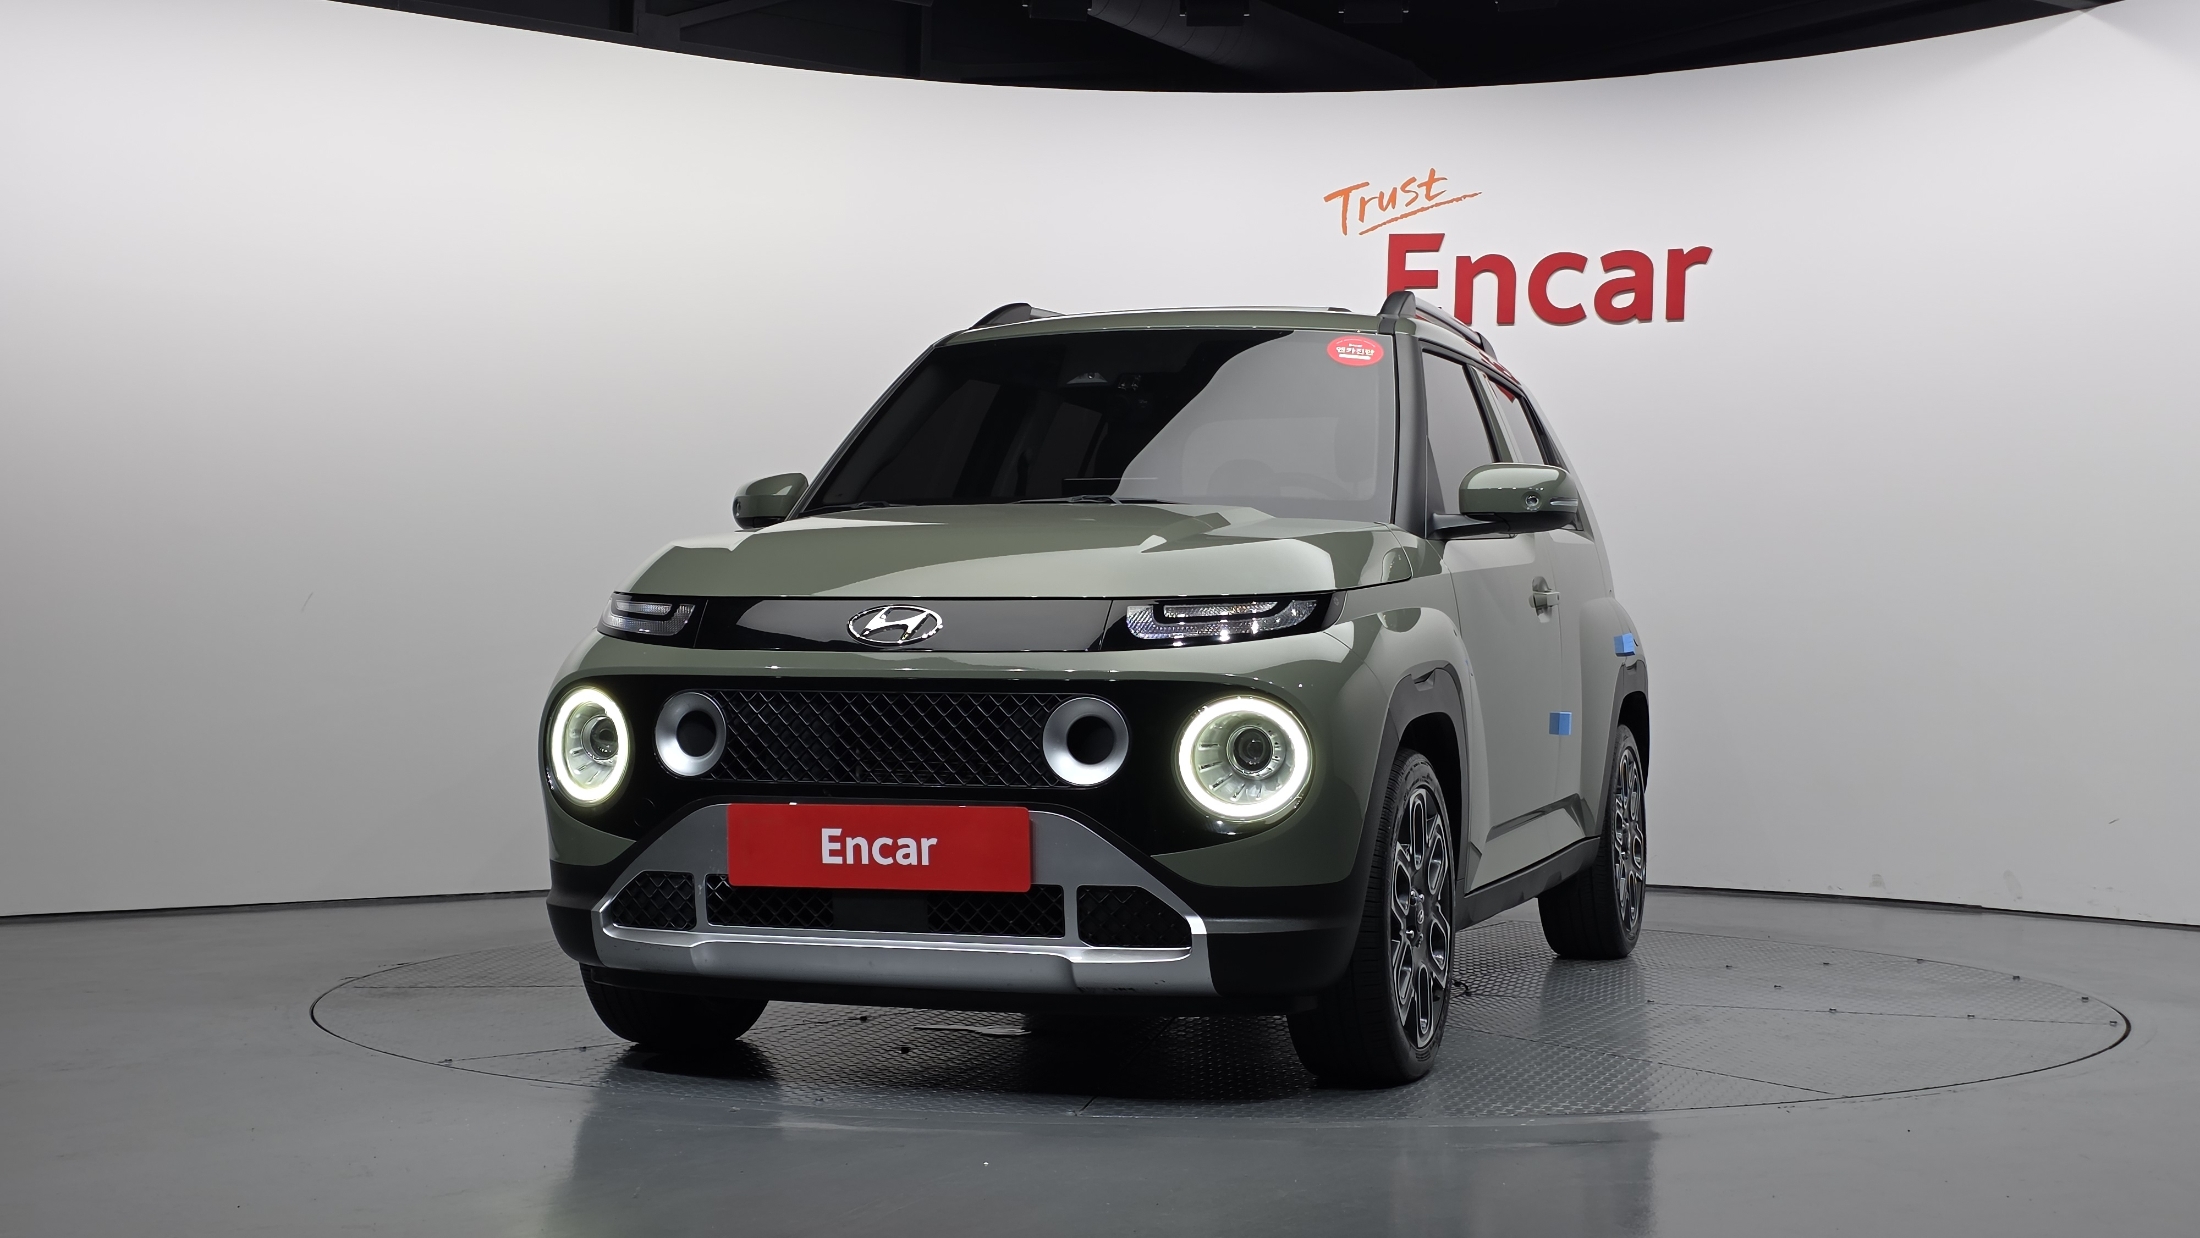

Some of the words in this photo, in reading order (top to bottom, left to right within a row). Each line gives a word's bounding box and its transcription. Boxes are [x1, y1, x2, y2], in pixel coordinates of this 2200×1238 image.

[1323, 167, 1449, 235] Trust
[1387, 233, 1713, 326] Encar
[821, 828, 938, 865] Encar
